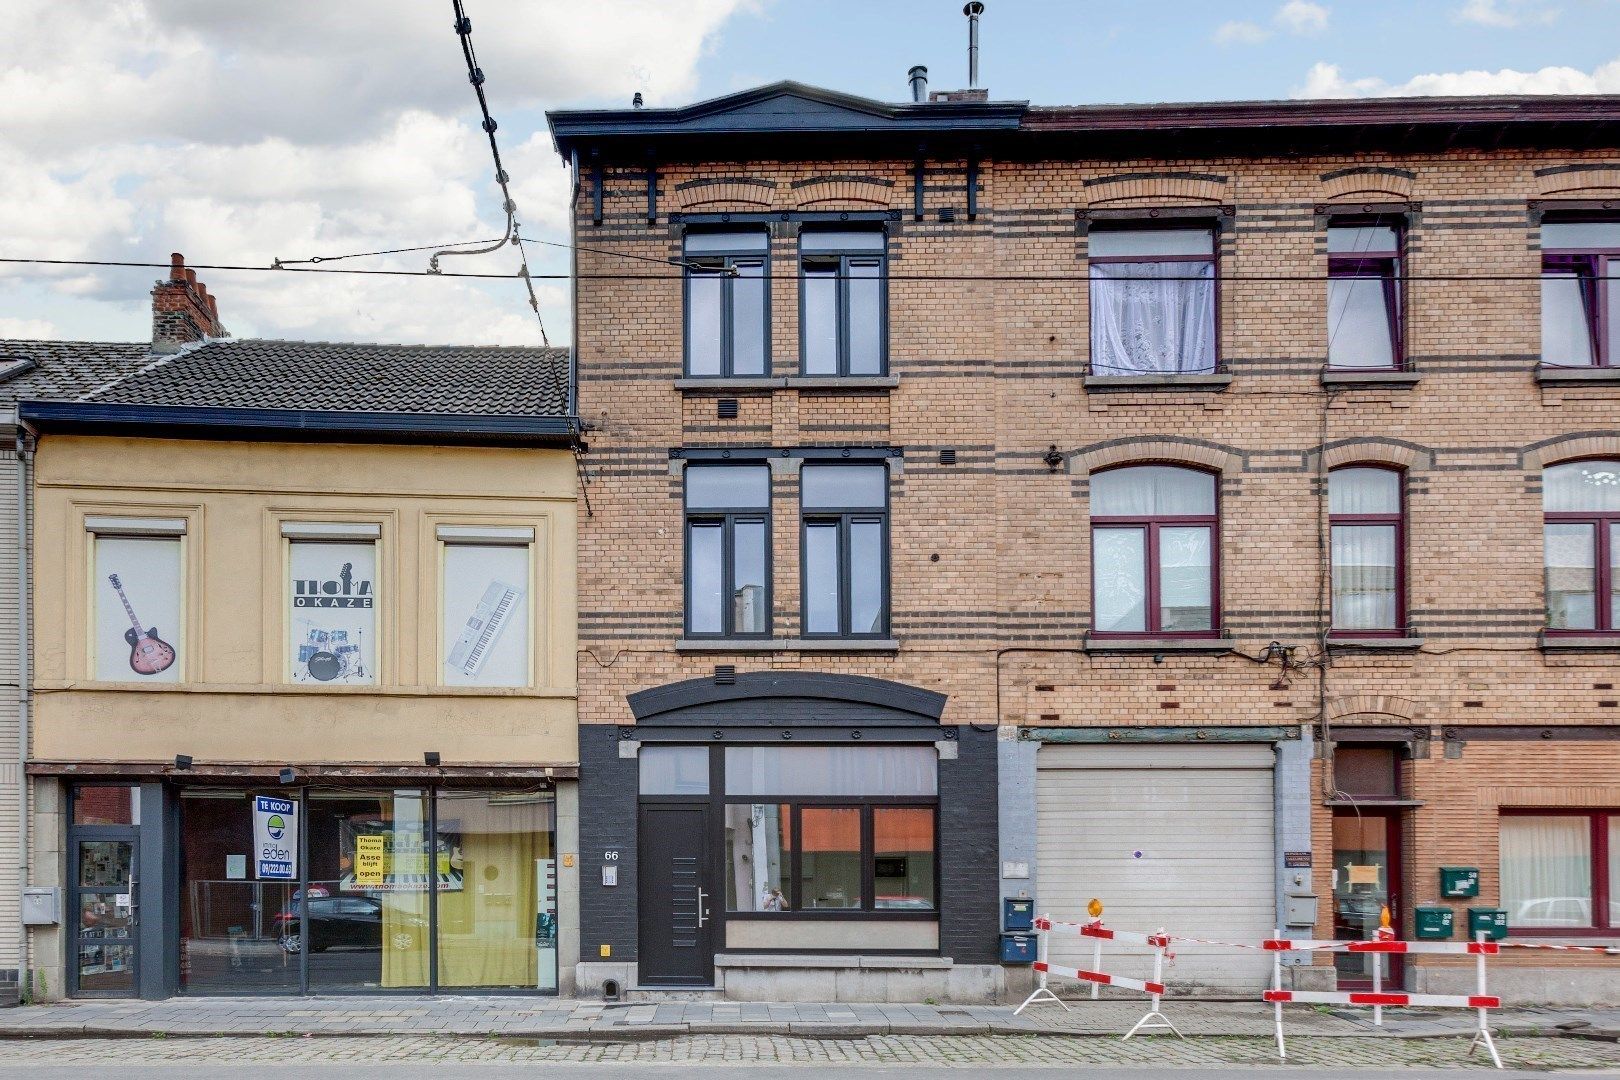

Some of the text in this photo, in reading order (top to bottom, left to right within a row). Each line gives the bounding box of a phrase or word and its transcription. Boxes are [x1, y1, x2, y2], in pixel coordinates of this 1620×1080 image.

[293, 579, 373, 595] THOMA
[296, 597, 371, 607] OKAZE
[260, 800, 291, 812] TE KOOP
[263, 844, 290, 860] eden
[604, 851, 619, 860] 66
